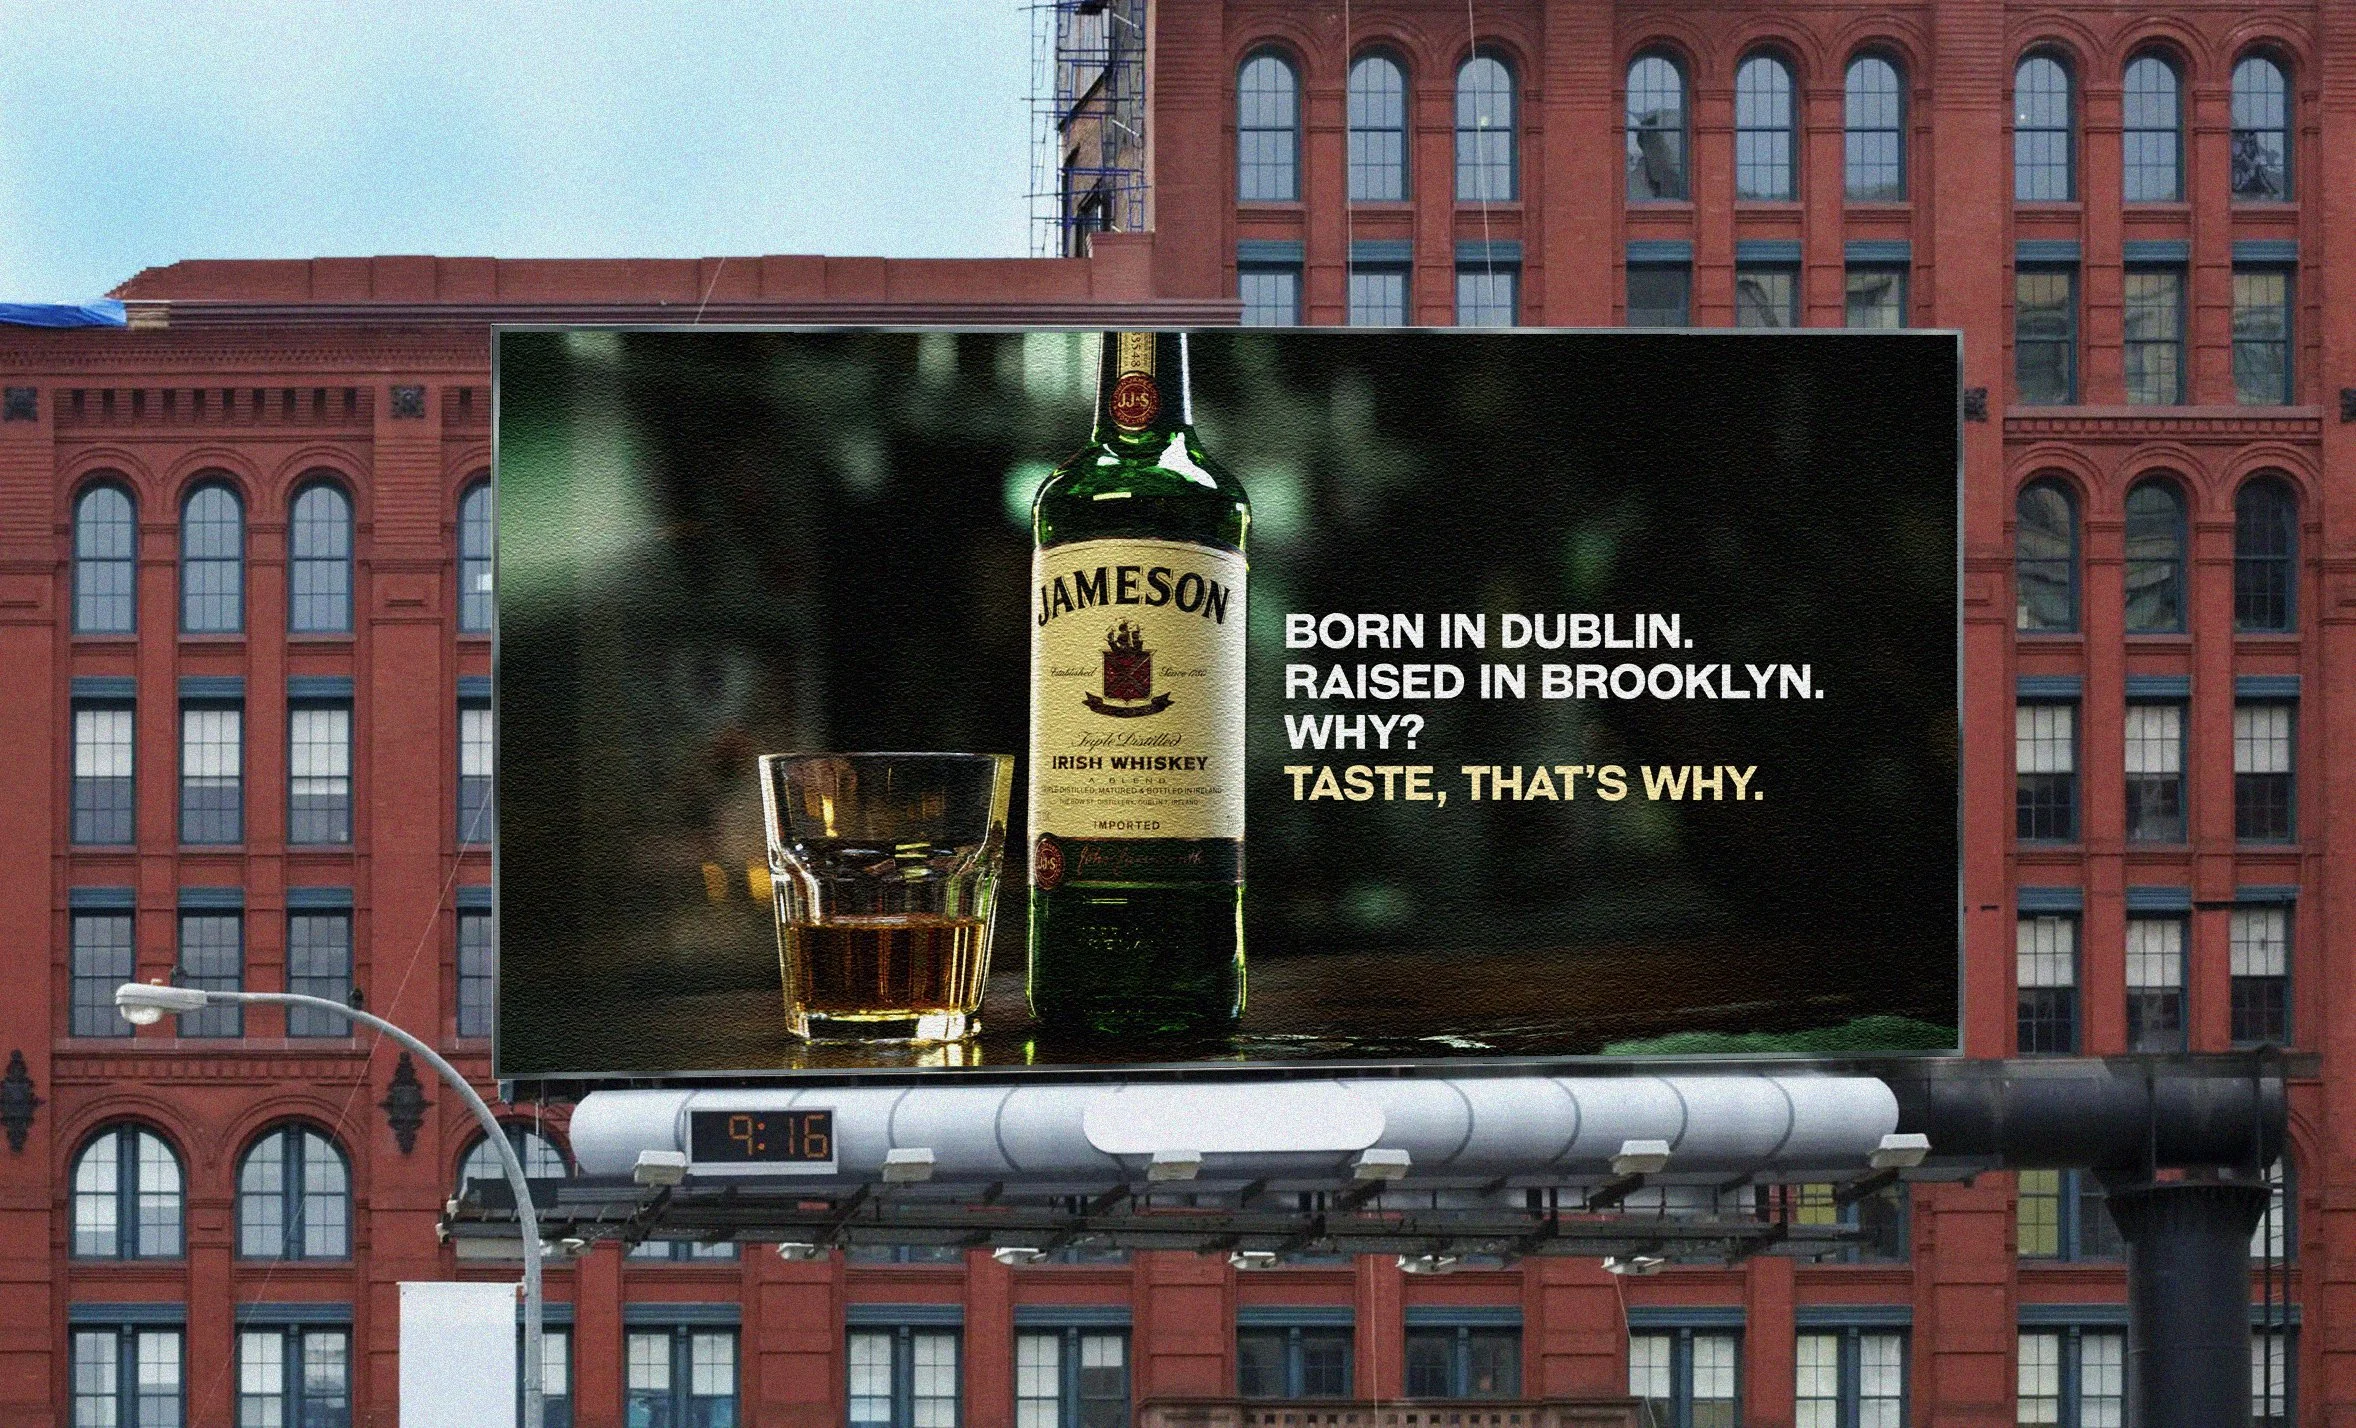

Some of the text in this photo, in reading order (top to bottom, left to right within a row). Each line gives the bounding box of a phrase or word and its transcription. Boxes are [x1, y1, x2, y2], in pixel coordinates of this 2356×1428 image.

[1038, 566, 1231, 627] JAMESON
[1285, 613, 1693, 649] BORN IN DUBLIN.
[1050, 666, 1098, 677] Established
[1159, 666, 1187, 677] Since
[1285, 663, 1824, 700] RAISED IN BROOKLYN.
[1073, 731, 1182, 752] Triple Distilled
[1284, 713, 1425, 750] WHY?
[1052, 756, 1209, 771] IRISH WHISKEY
[1099, 786, 1138, 795] MATURED
[1146, 786, 1184, 795] BOTTLED
[1193, 786, 1223, 795] IRELAND
[1284, 764, 1764, 808] TASTE, THAT’S WHY.
[1093, 820, 1161, 831] IMPORTED
[728, 1113, 828, 1159] 9:16
